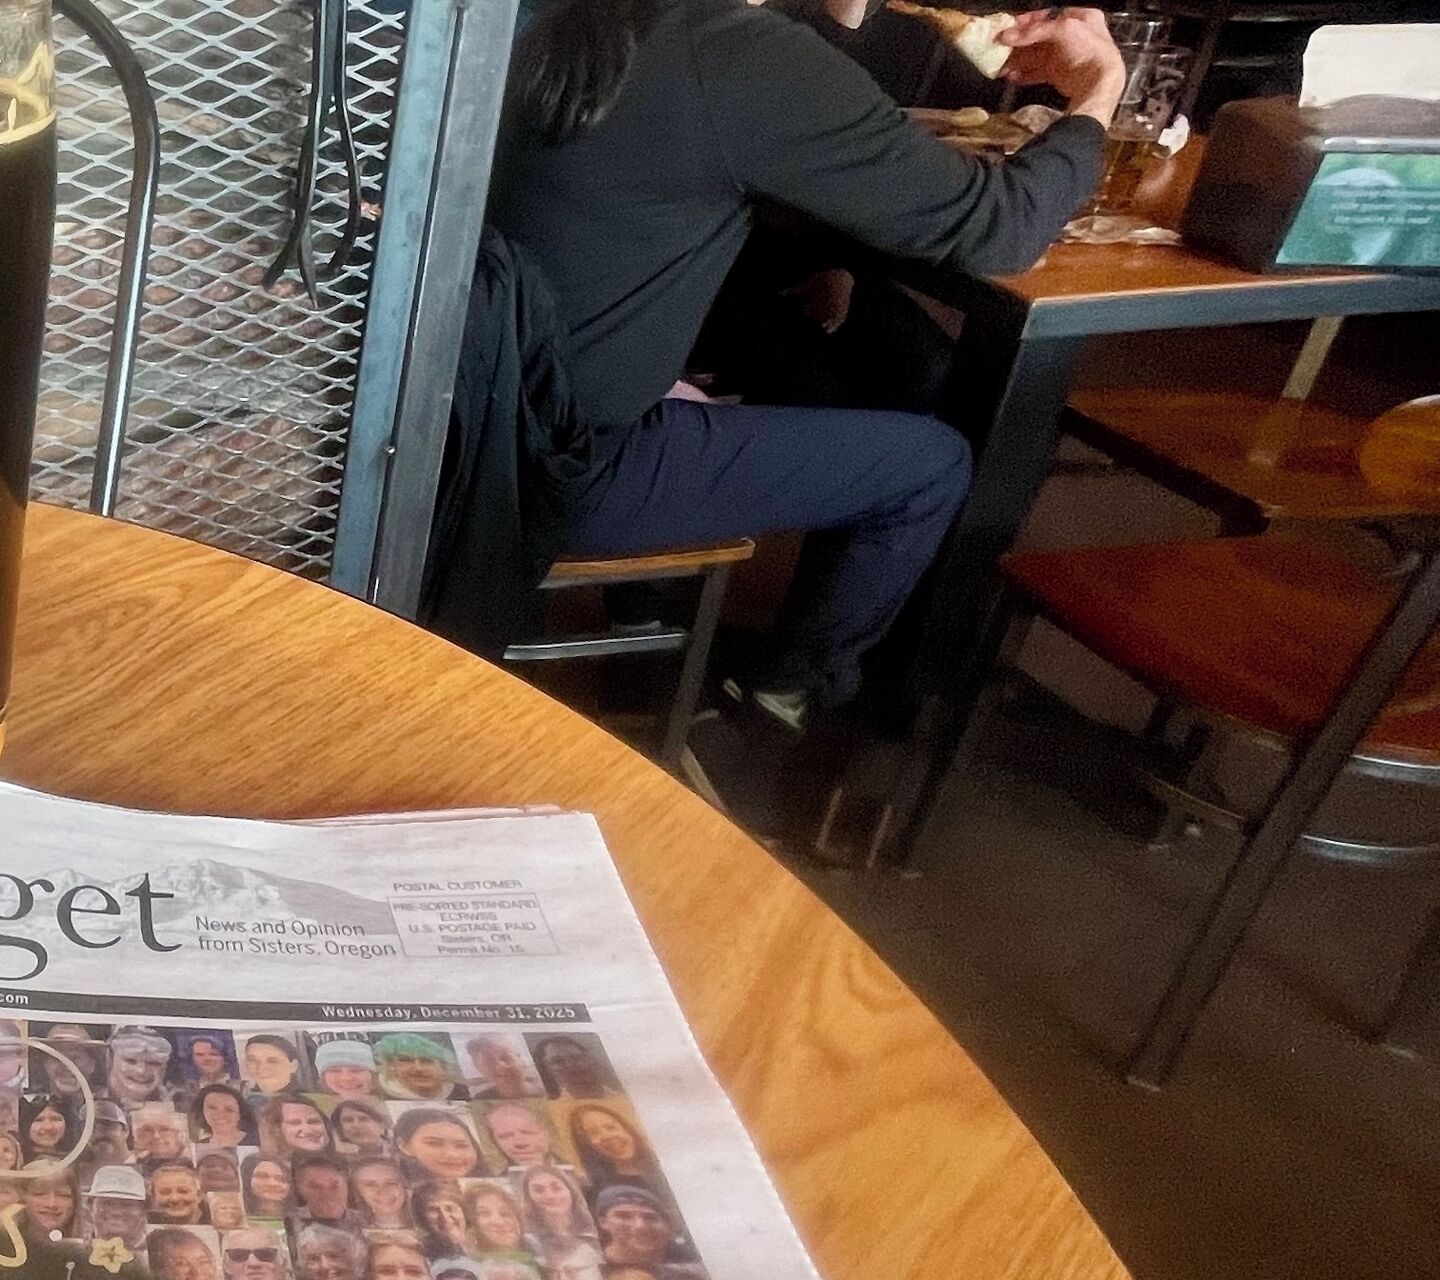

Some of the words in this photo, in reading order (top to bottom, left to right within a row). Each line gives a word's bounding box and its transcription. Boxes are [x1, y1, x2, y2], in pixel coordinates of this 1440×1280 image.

[393, 882, 445, 892] POSTAL
[447, 880, 522, 891] CUSTOMER
[195, 916, 246, 933] News
[252, 920, 286, 935] and
[291, 920, 365, 938] Opinion
[439, 923, 500, 933] POSTAGE
[505, 922, 536, 931] PAID
[199, 935, 244, 952] from
[249, 937, 321, 956] Sisters,
[325, 940, 396, 959] Oregon
[321, 1005, 417, 1019] Wednesday,
[421, 1006, 500, 1019] December
[535, 1007, 576, 1019] 2025
